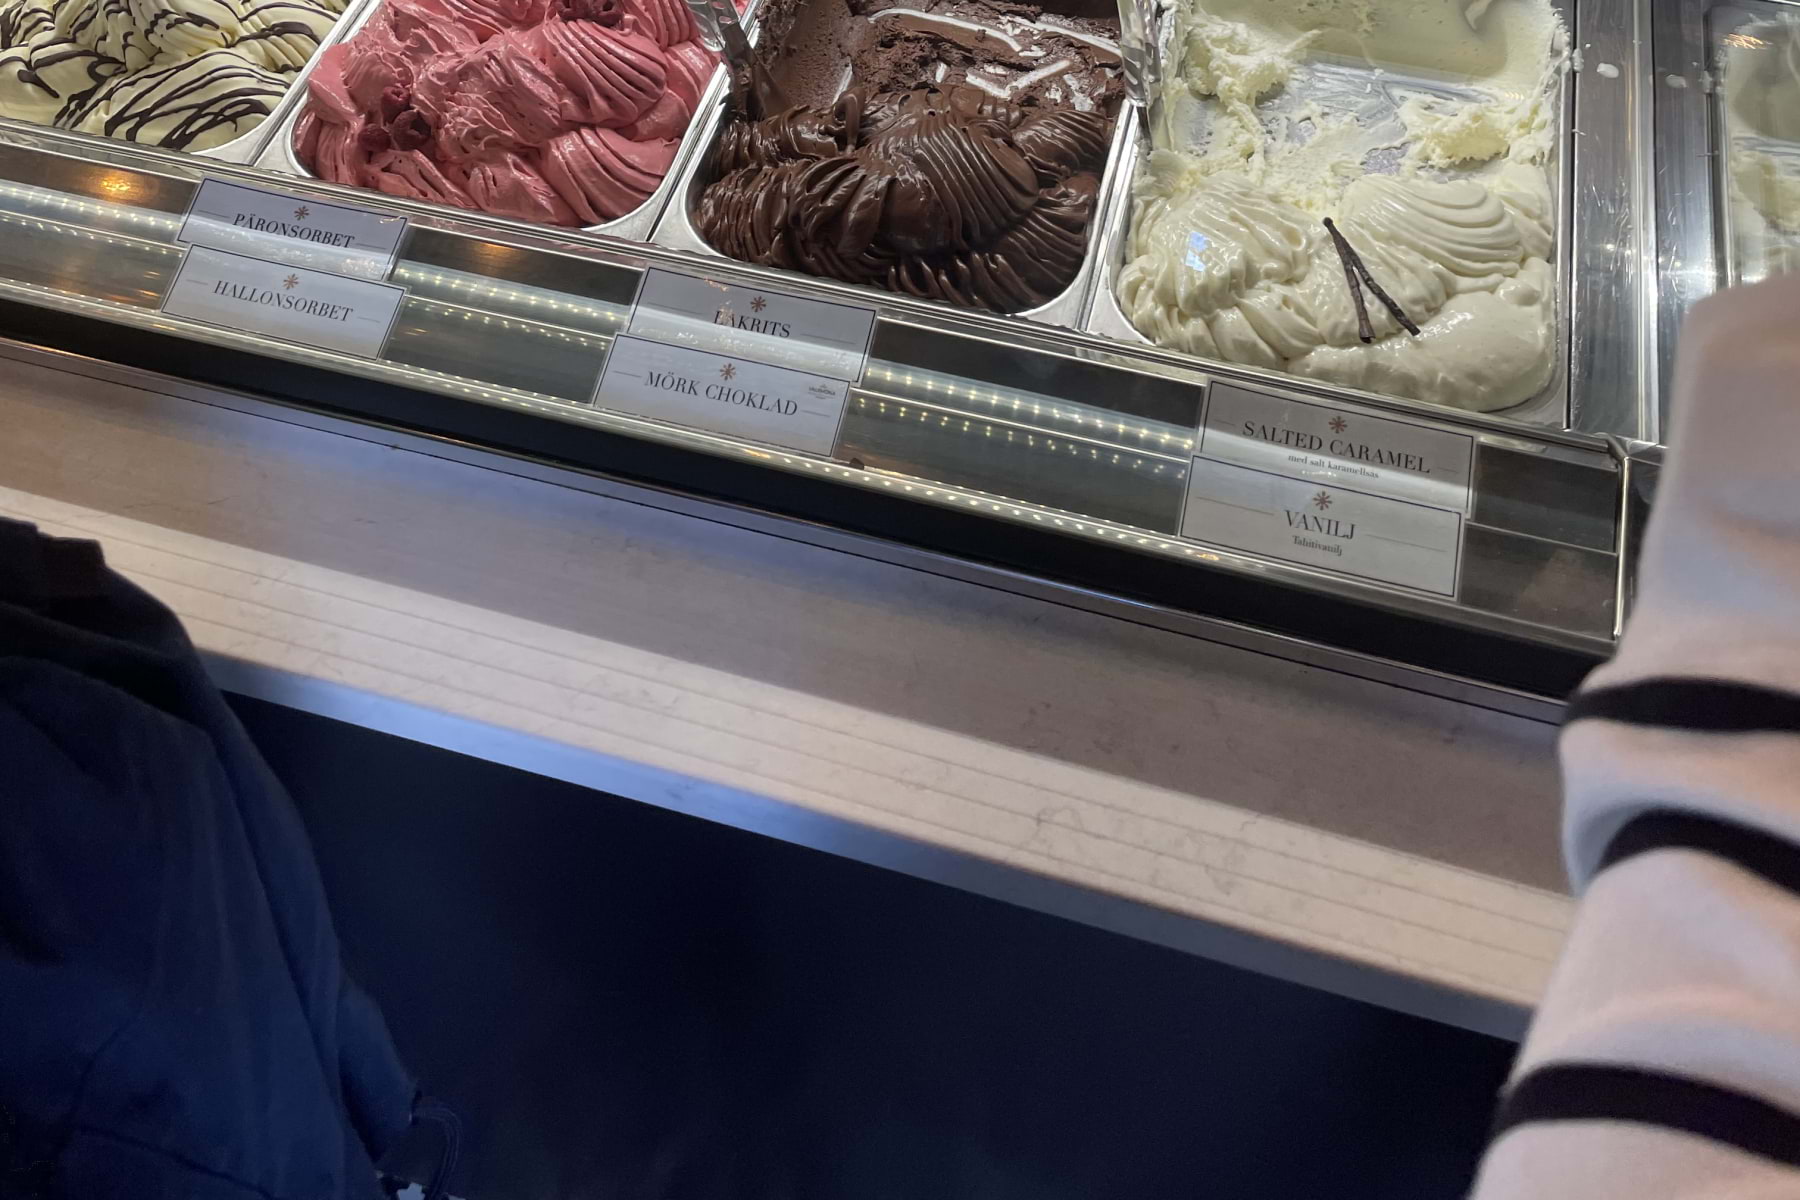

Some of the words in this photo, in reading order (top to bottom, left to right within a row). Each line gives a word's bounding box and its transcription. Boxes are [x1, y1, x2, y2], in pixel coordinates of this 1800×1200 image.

[232, 213, 356, 249] PÄRONSORBET
[213, 280, 354, 322] HALLONSORBET
[644, 370, 701, 396] MÖRK
[704, 383, 799, 417] CHOKLAD
[1242, 420, 1323, 451] SALTED
[1329, 439, 1431, 474] CARAMEL
[1287, 455, 1308, 465] med
[1310, 459, 1325, 468] salt
[1284, 509, 1356, 540] VANILJ
